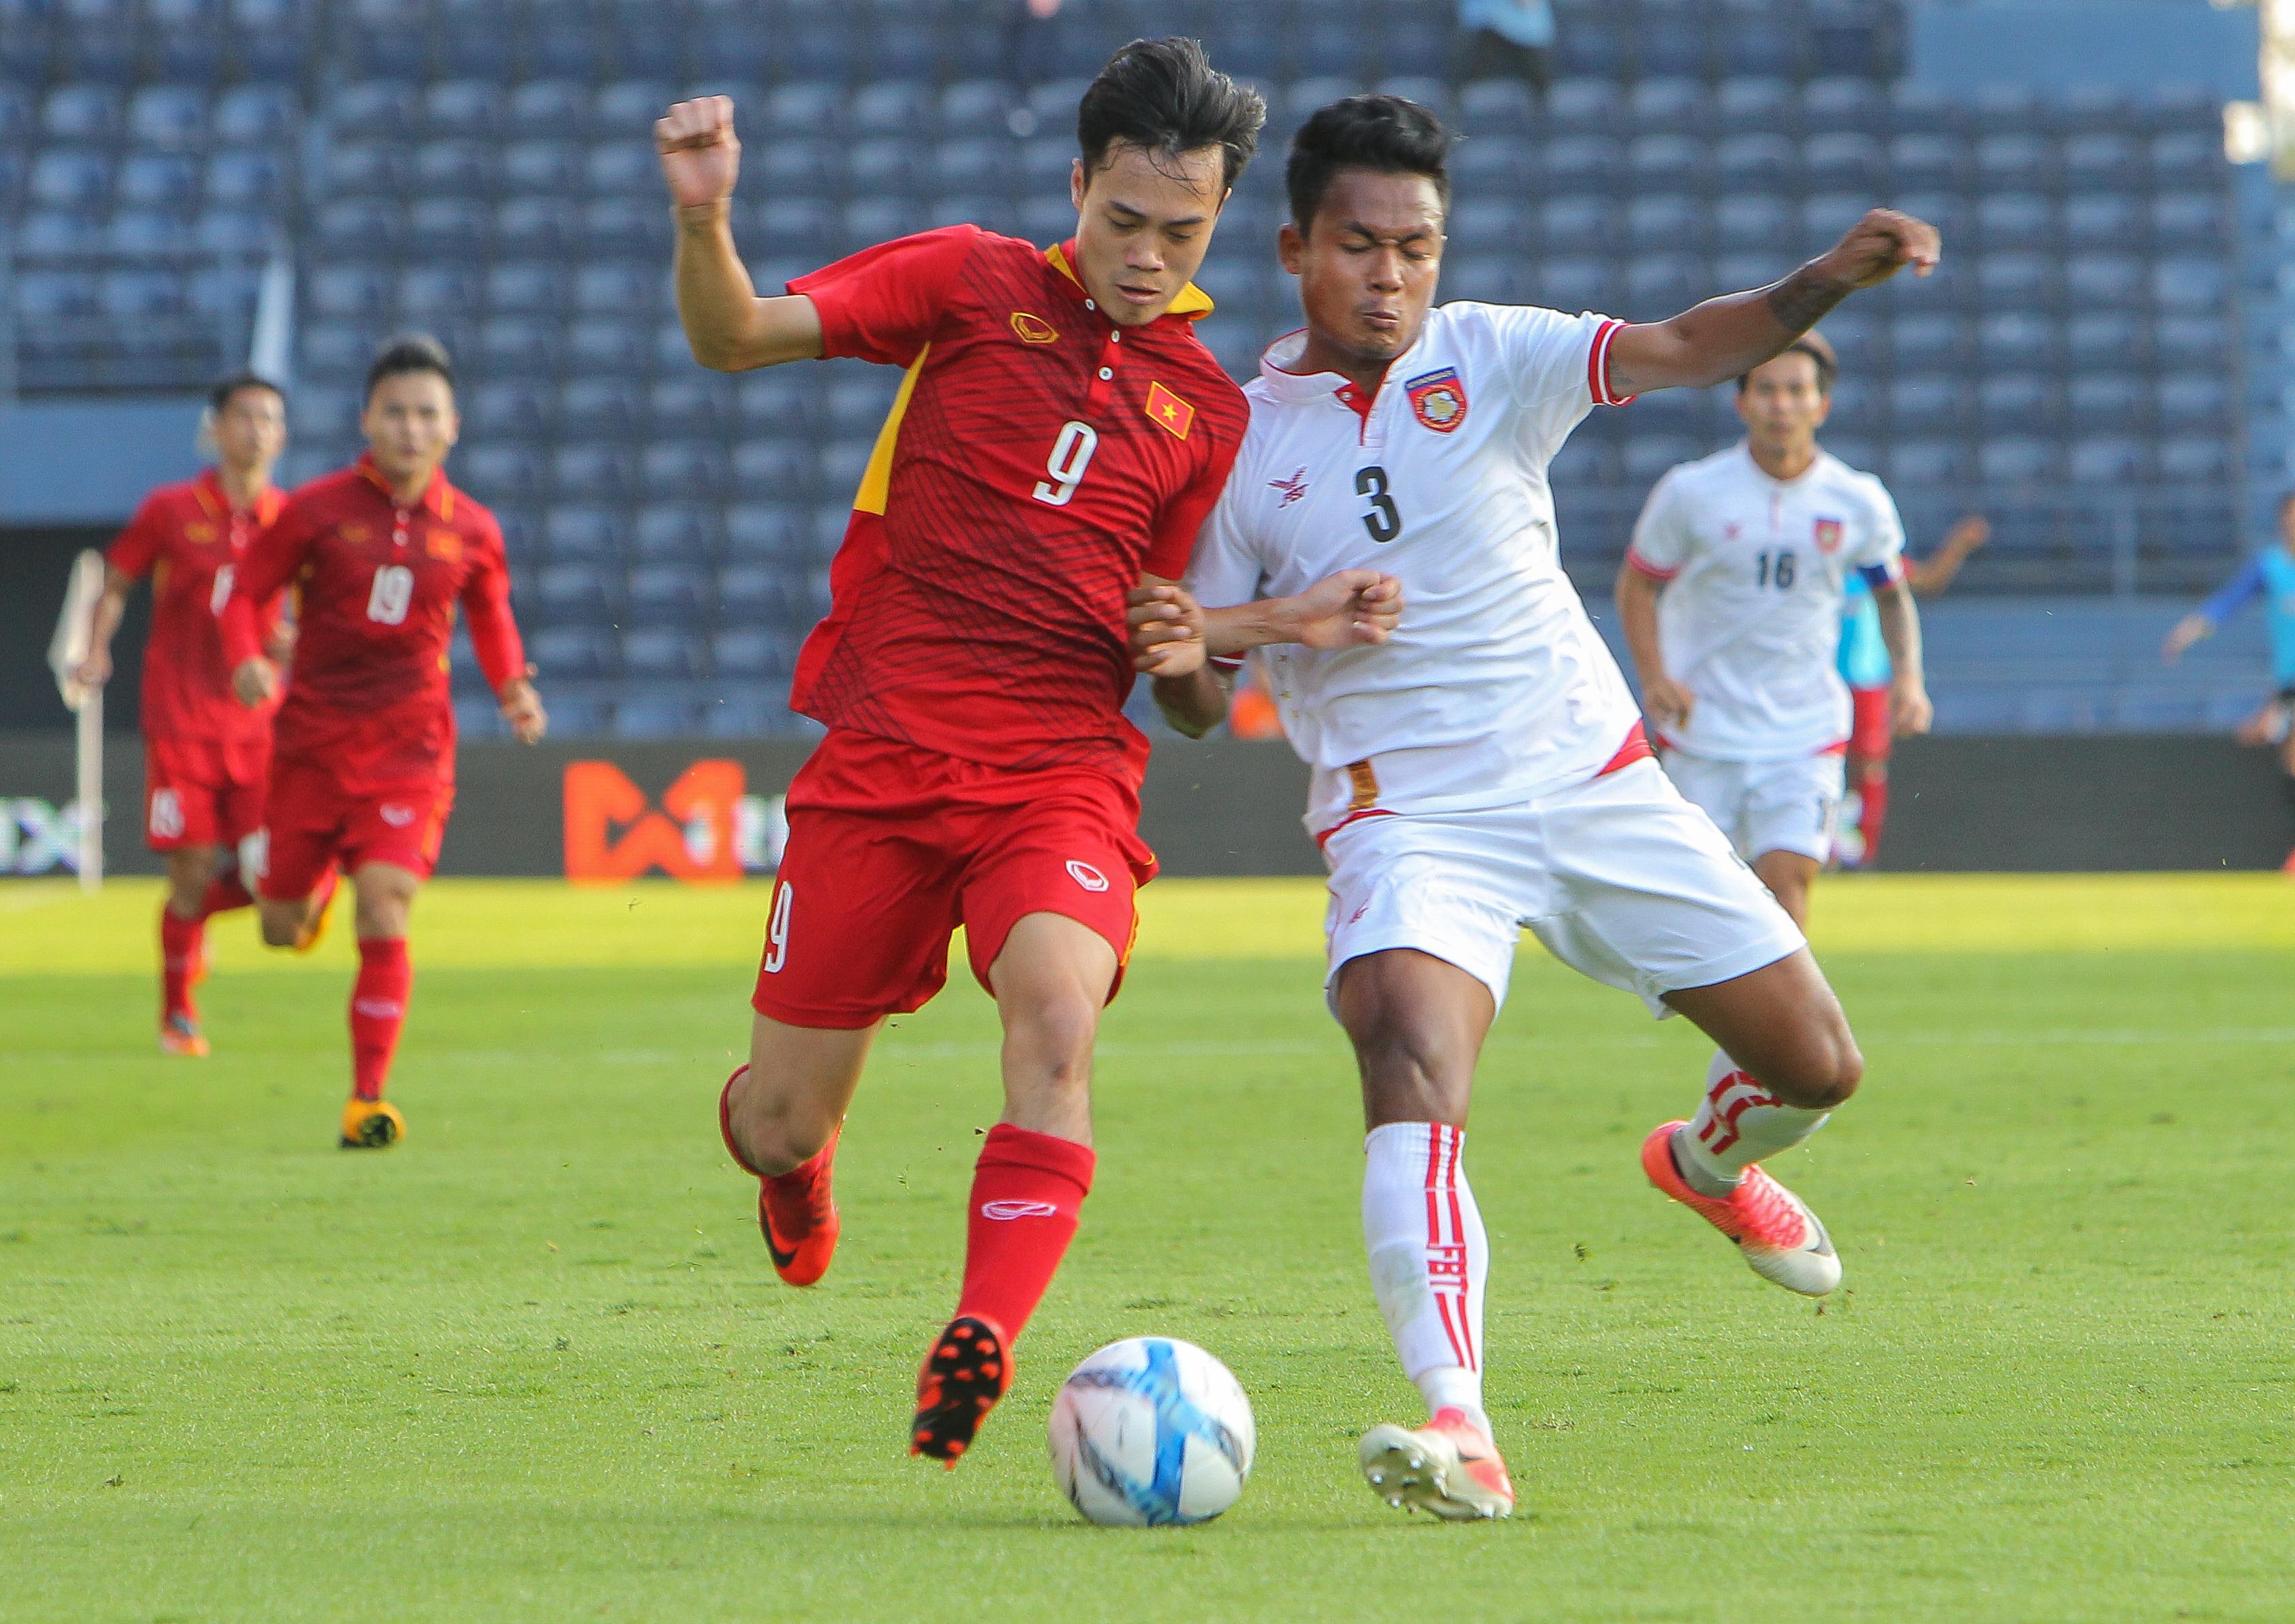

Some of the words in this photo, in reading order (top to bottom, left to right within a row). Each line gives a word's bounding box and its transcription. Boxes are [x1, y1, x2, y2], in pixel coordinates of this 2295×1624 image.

[1032, 421, 1098, 506] 9
[1356, 466, 1401, 543] 3
[367, 565, 415, 625] 19
[1754, 549, 1795, 590] 16
[764, 881, 793, 973] 9
[1426, 1244, 1468, 1294] FBT
